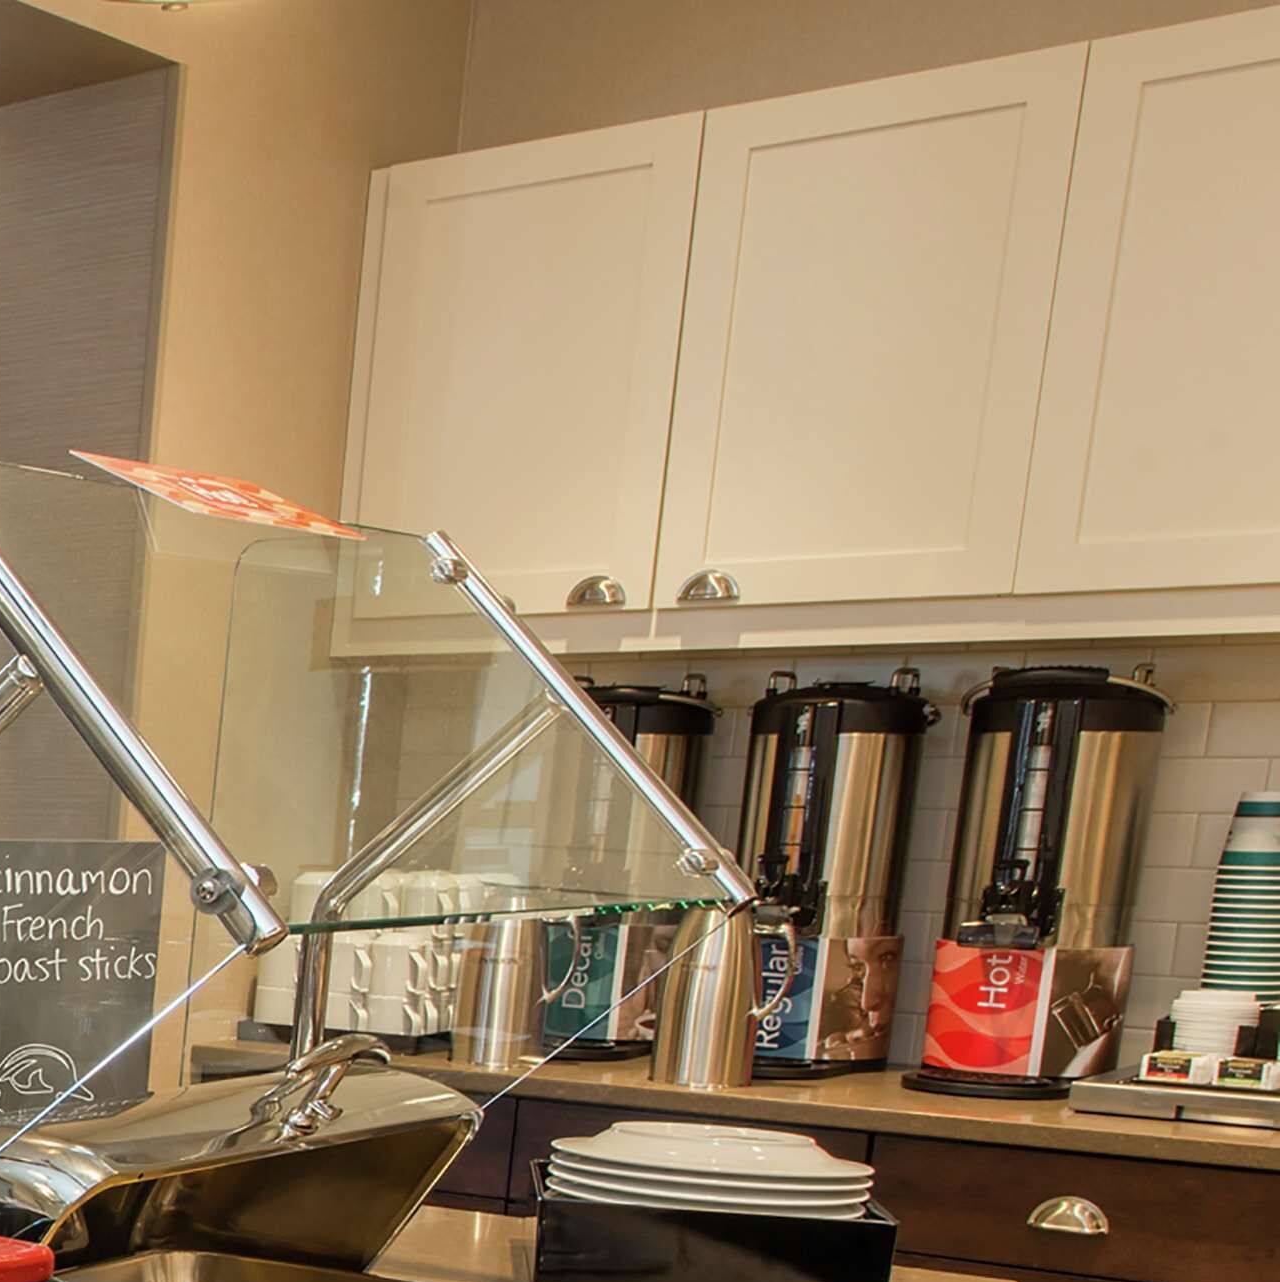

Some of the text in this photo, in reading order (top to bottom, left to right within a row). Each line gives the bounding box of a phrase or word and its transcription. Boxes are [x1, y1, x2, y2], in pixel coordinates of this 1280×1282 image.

[2, 903, 105, 943] French
[78, 946, 157, 982] sticks
[977, 954, 1013, 1008] Hot
[754, 943, 792, 1049] Regular
